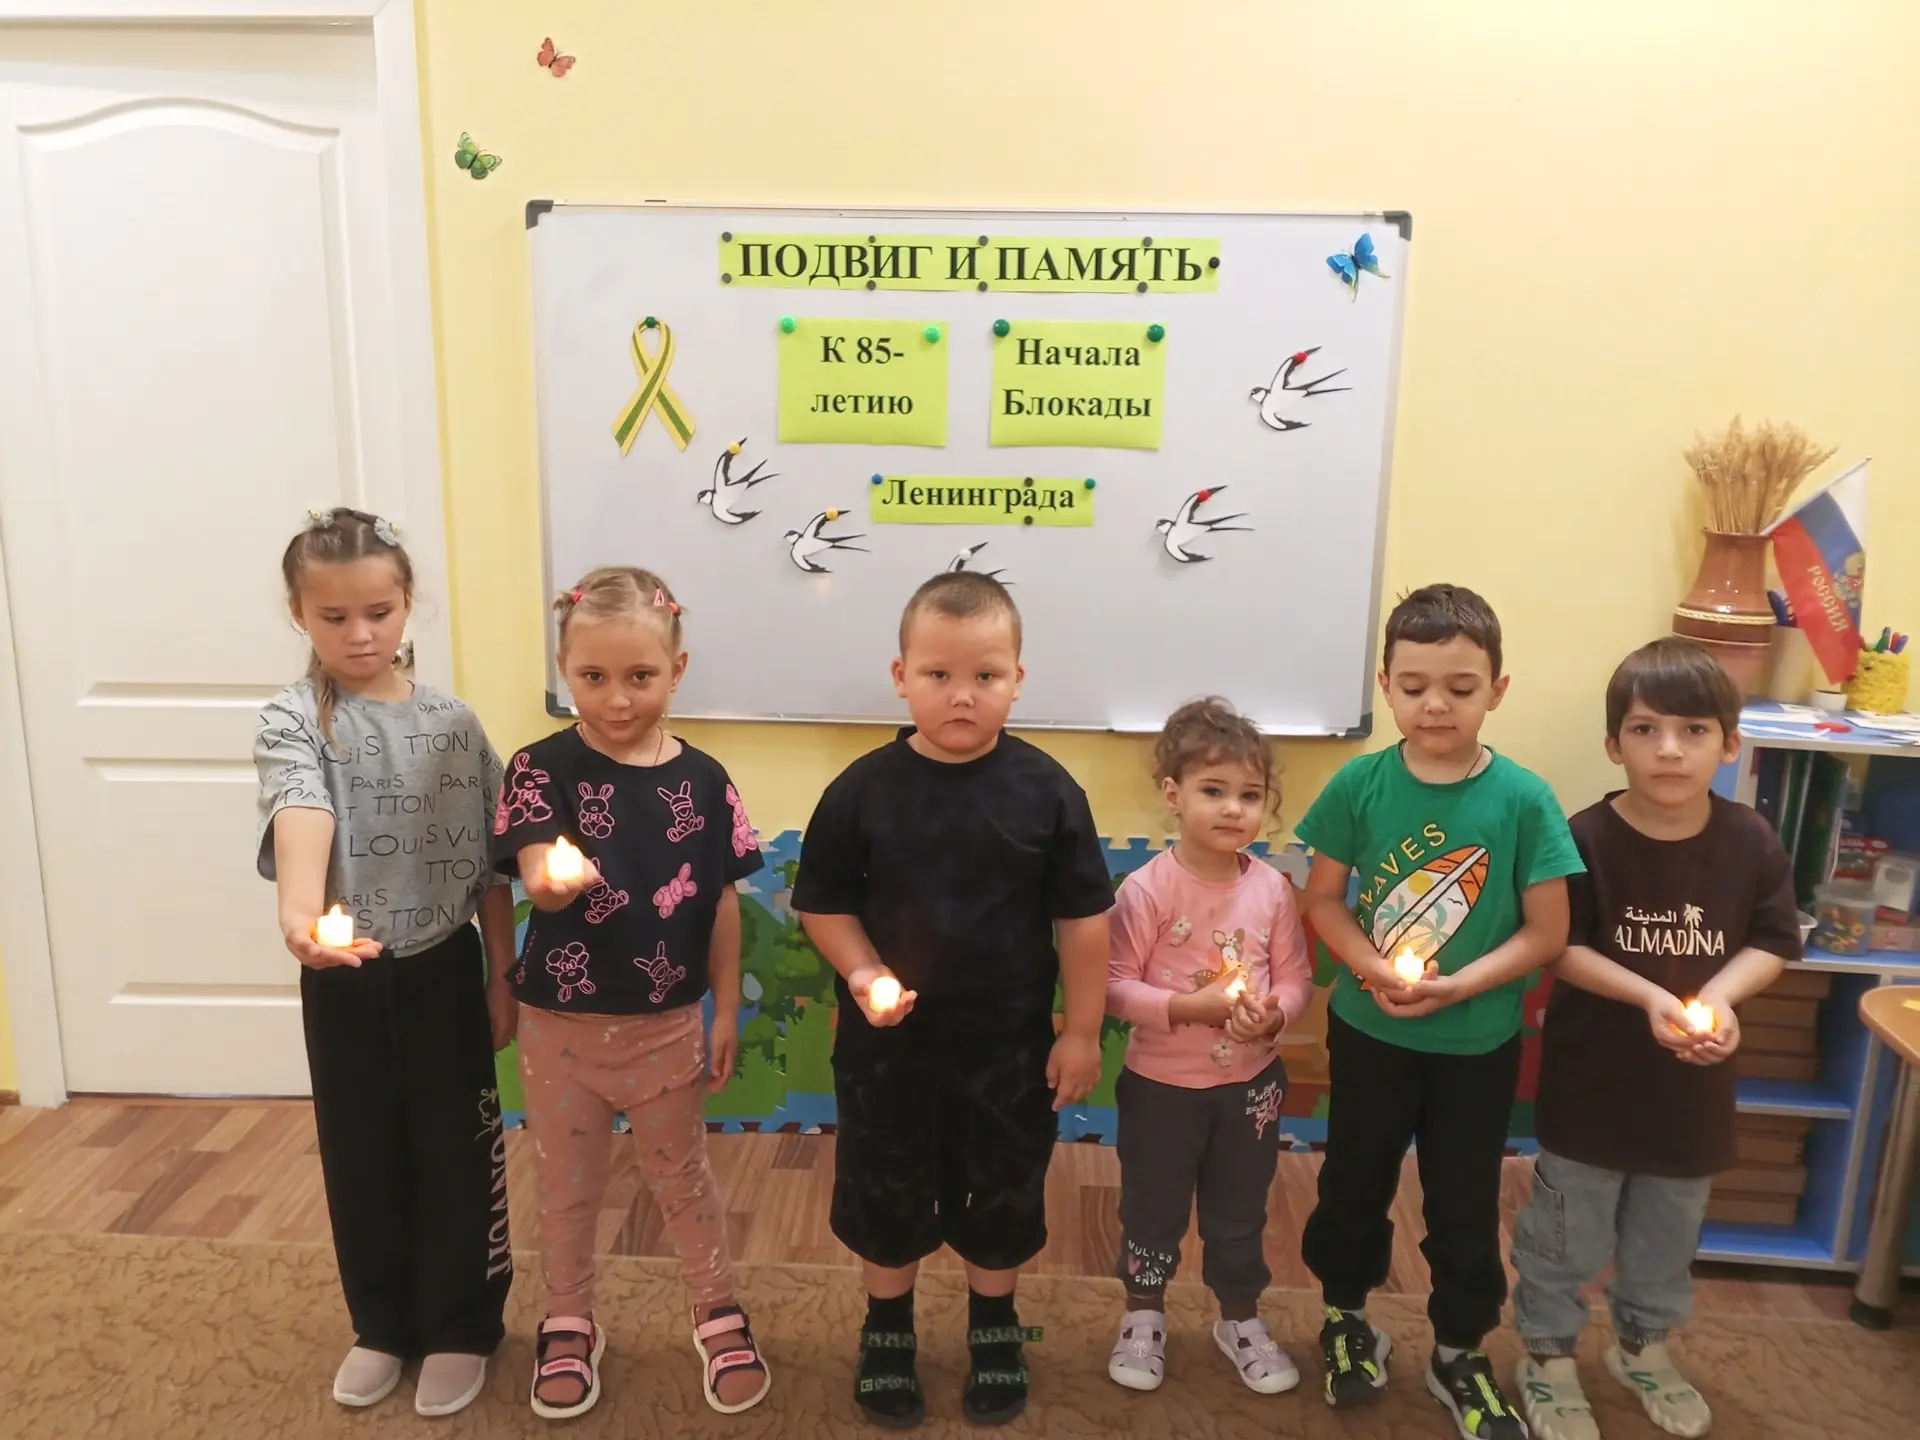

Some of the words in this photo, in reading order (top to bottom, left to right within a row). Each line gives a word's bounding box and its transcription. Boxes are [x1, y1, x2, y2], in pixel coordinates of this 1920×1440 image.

[738, 243, 933, 286] ПОДВИГ
[945, 245, 981, 280] И
[994, 246, 1203, 281] ПАМЯТЬ
[820, 335, 846, 363] К
[856, 336, 904, 364] 85-
[1015, 338, 1141, 366] Начала
[811, 394, 914, 415] летию
[1001, 388, 1152, 420] Блокады
[882, 479, 1075, 514] Ленинграда
[1807, 564, 1849, 632] РОССИЯ
[417, 699, 466, 715] PARIS
[350, 773, 405, 792] PARIS
[350, 823, 439, 858] LOUIS
[1624, 906, 1678, 925] المدينة
